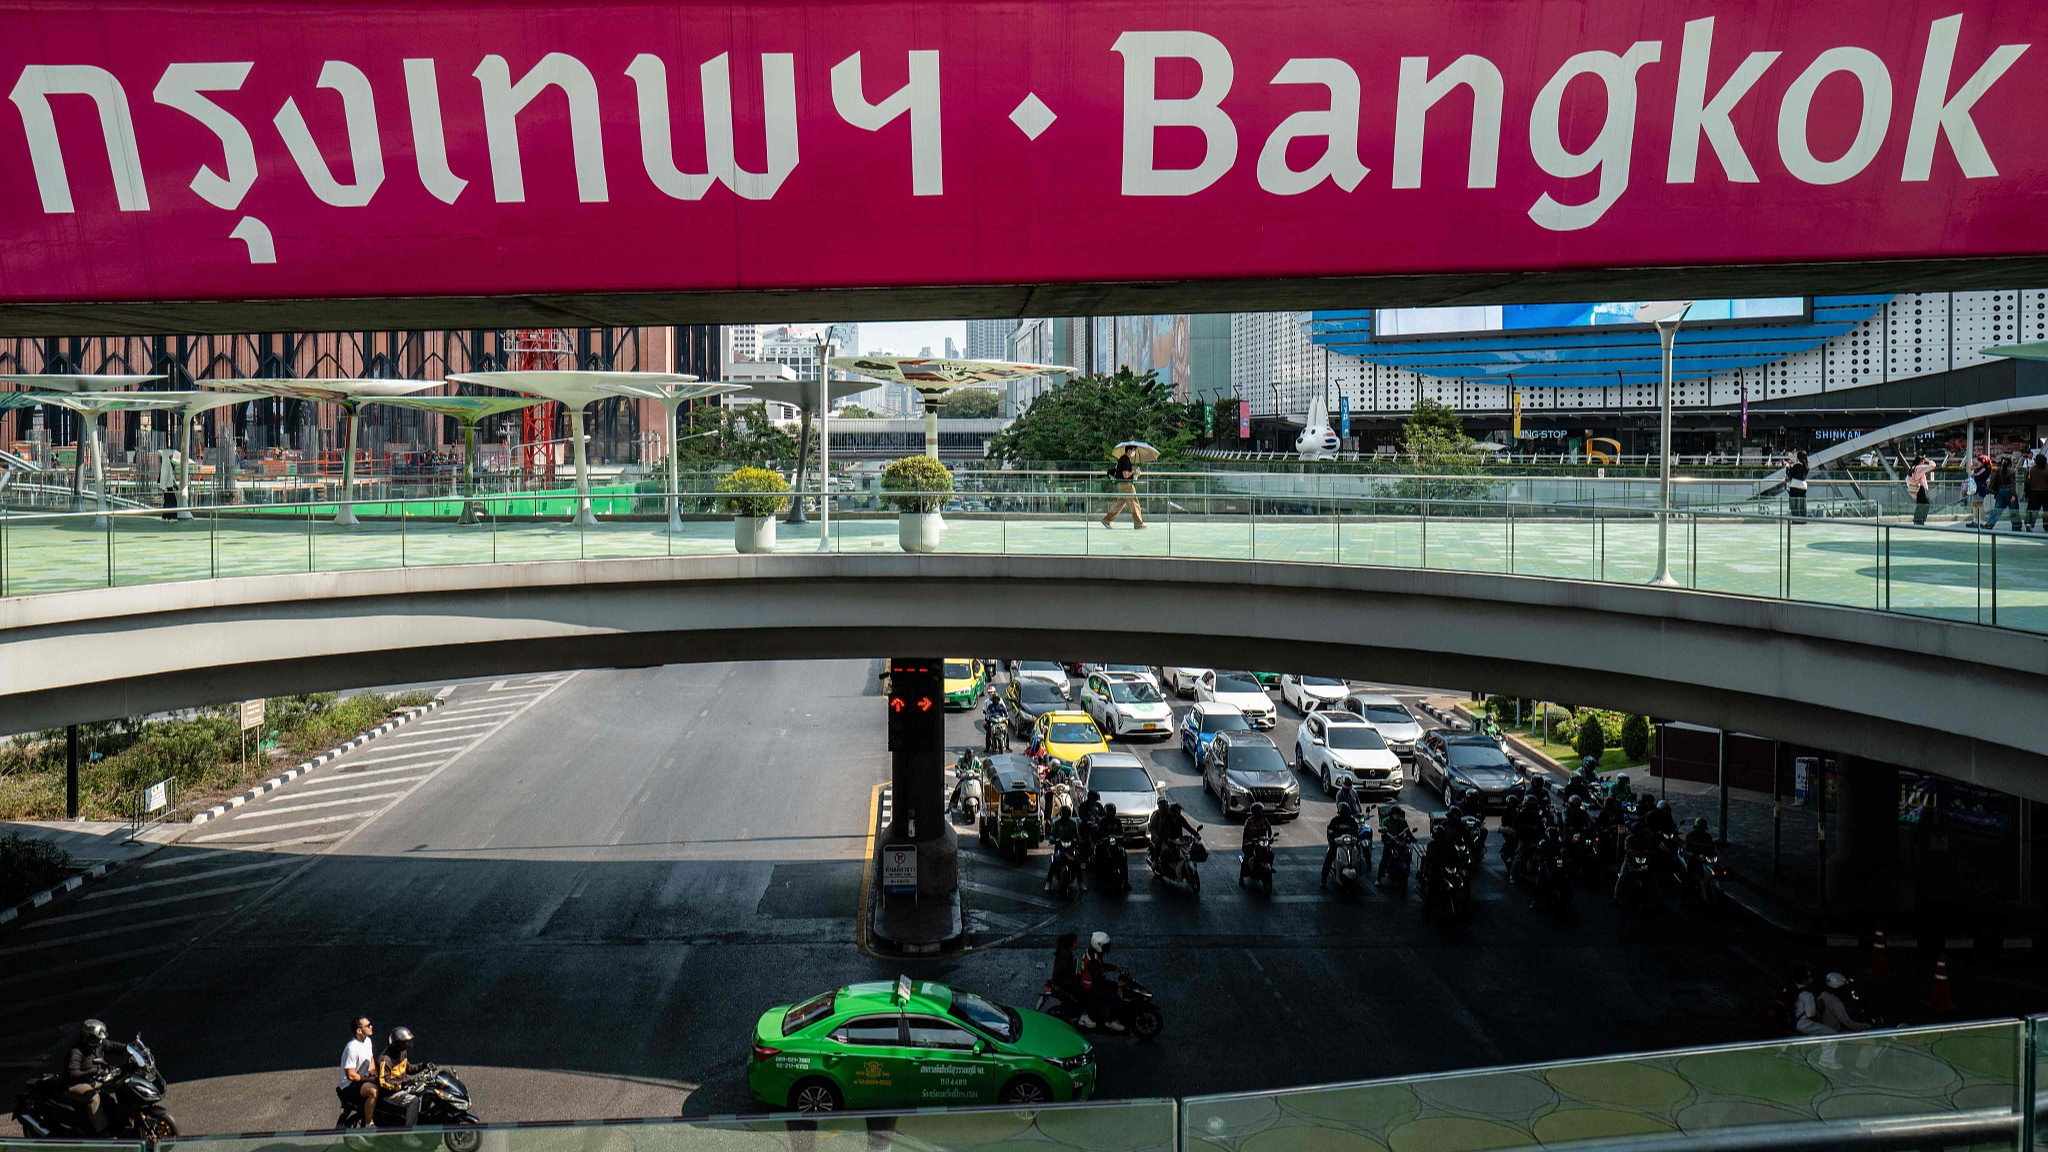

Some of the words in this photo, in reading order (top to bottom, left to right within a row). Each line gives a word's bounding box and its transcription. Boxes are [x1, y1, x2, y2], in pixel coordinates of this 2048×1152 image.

[8, 50, 943, 264] กรุงเทพฯ
[1110, 13, 2031, 232] Bangkok
